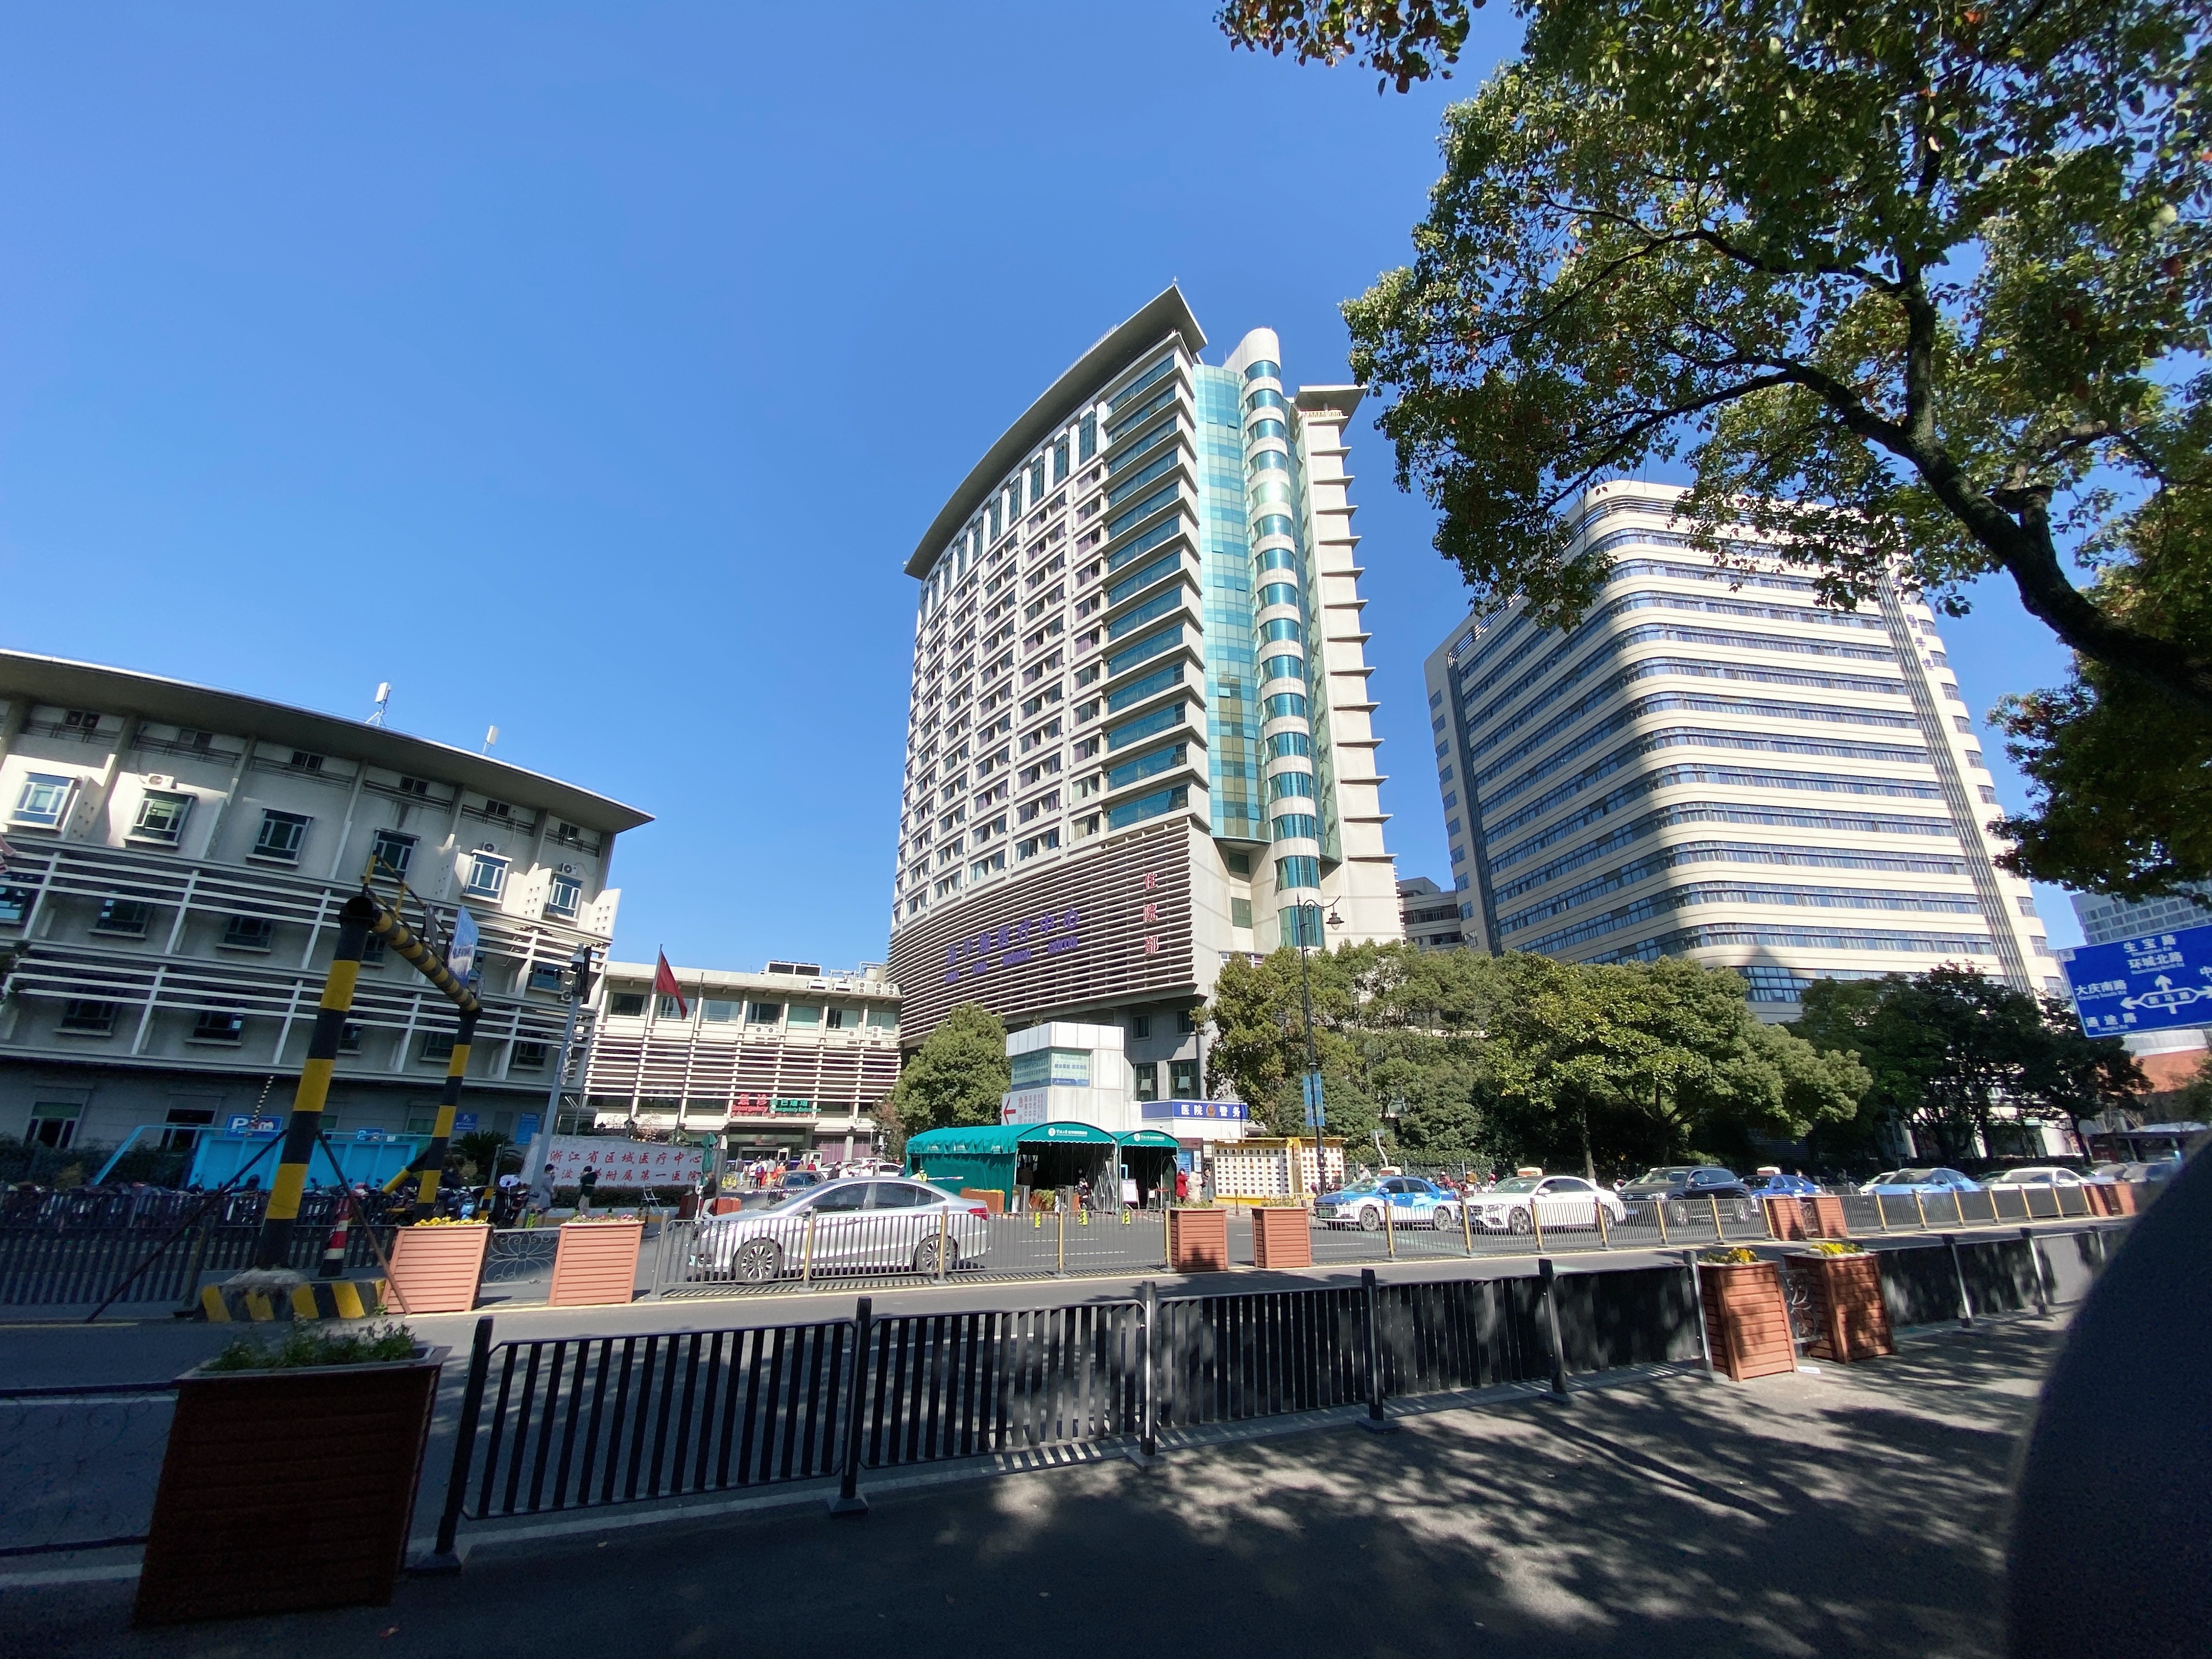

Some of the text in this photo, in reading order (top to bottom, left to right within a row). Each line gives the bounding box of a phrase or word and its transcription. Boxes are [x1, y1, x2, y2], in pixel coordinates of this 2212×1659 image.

[1143, 872, 1159, 954] 住院部
[2123, 934, 2177, 953] 生宝路
[2127, 951, 2184, 969] 环城北路
[2075, 979, 2127, 996] 大庆南路
[2085, 1012, 2137, 1028] 通途路
[738, 1093, 768, 1106] 急诊
[731, 1104, 768, 1113] Emergency
[550, 1150, 702, 1166] 浙江省区域医疗中心
